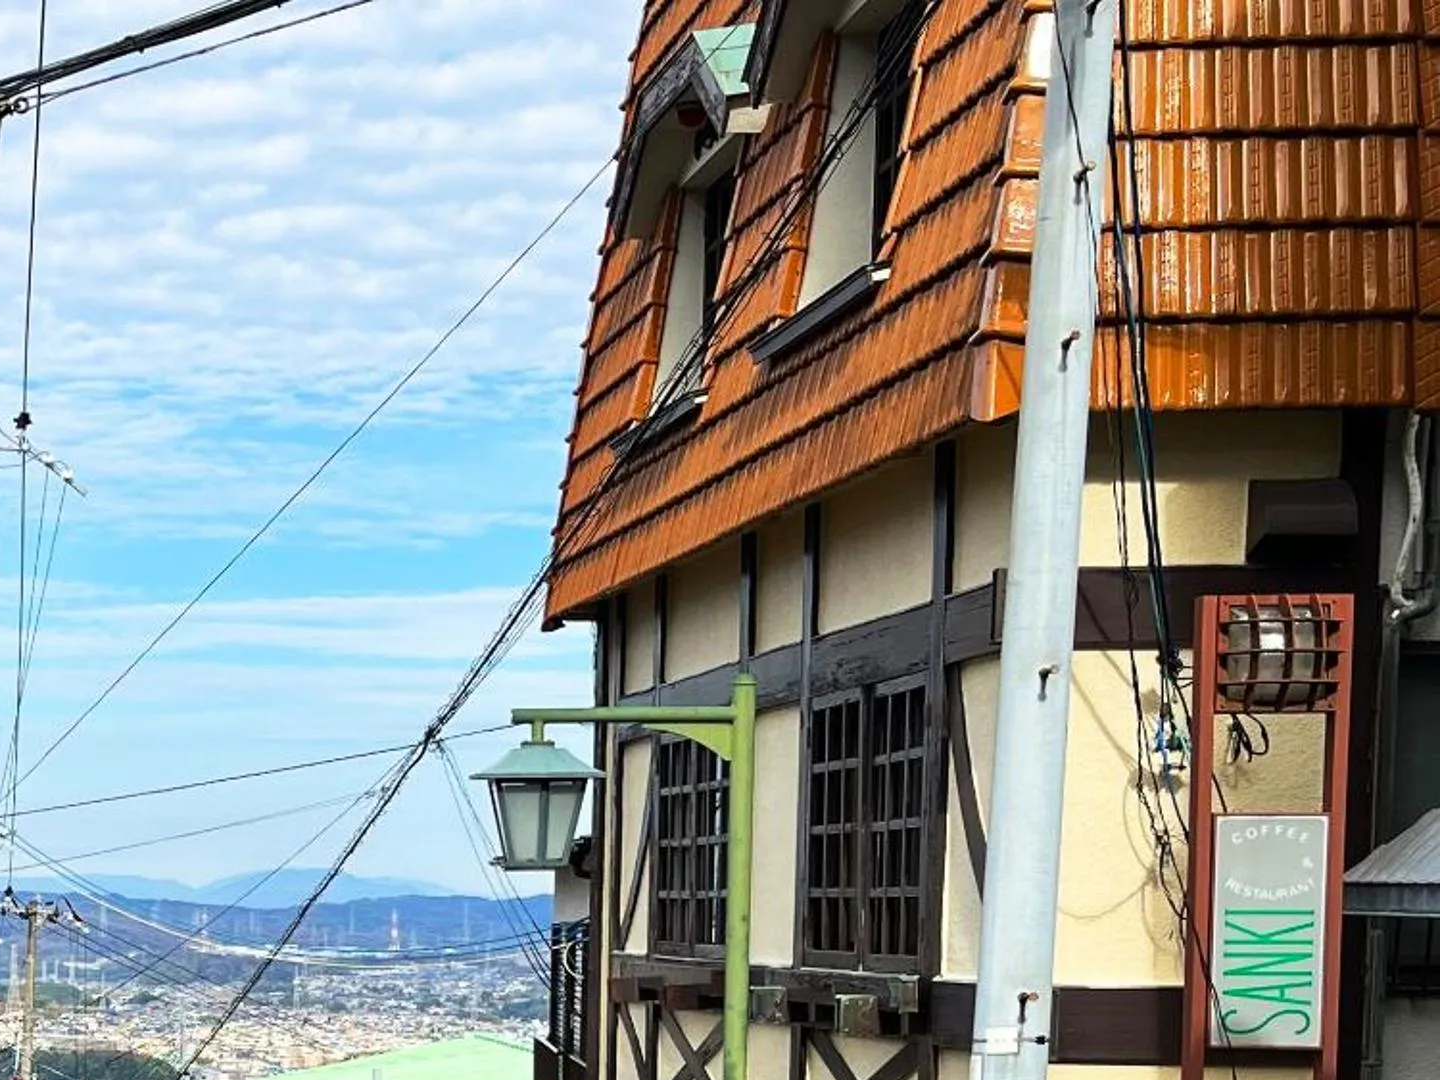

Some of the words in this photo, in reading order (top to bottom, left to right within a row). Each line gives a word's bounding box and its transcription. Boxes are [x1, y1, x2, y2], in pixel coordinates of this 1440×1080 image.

[1231, 824, 1310, 845] COFFEE
[1225, 877, 1315, 901] RESTAURANT
[1222, 909, 1315, 1034] SANKI
